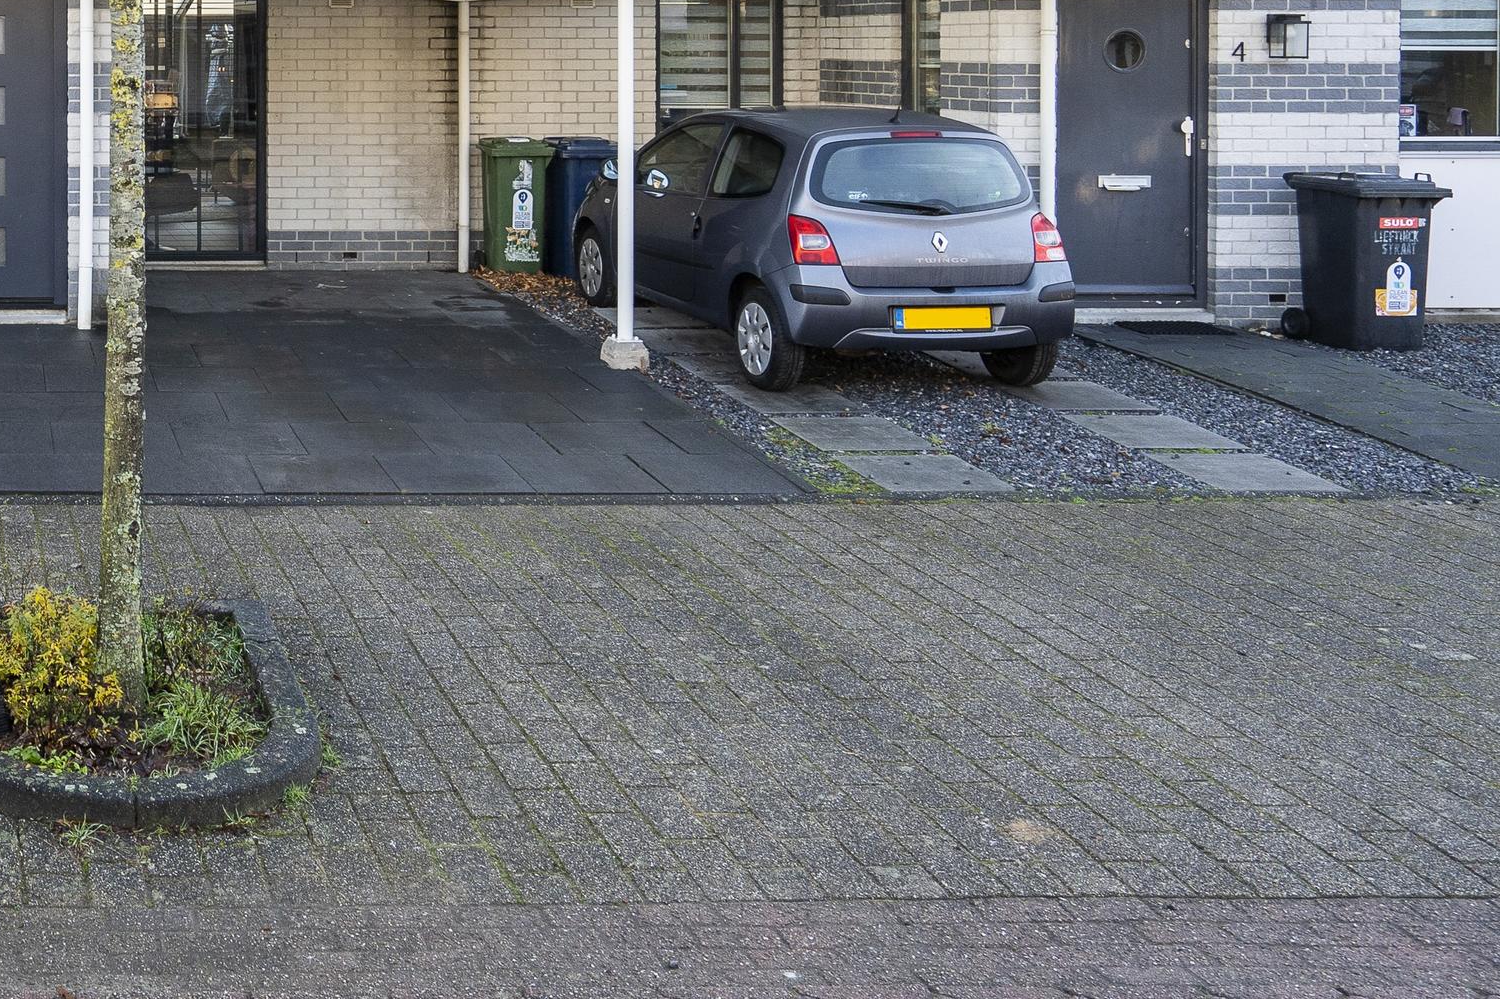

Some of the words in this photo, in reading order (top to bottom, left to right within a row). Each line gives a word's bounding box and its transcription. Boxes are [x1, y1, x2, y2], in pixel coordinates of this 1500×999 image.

[1231, 41, 1247, 62] 4
[1383, 218, 1414, 227] SULO
[1382, 243, 1416, 255] STRAAT
